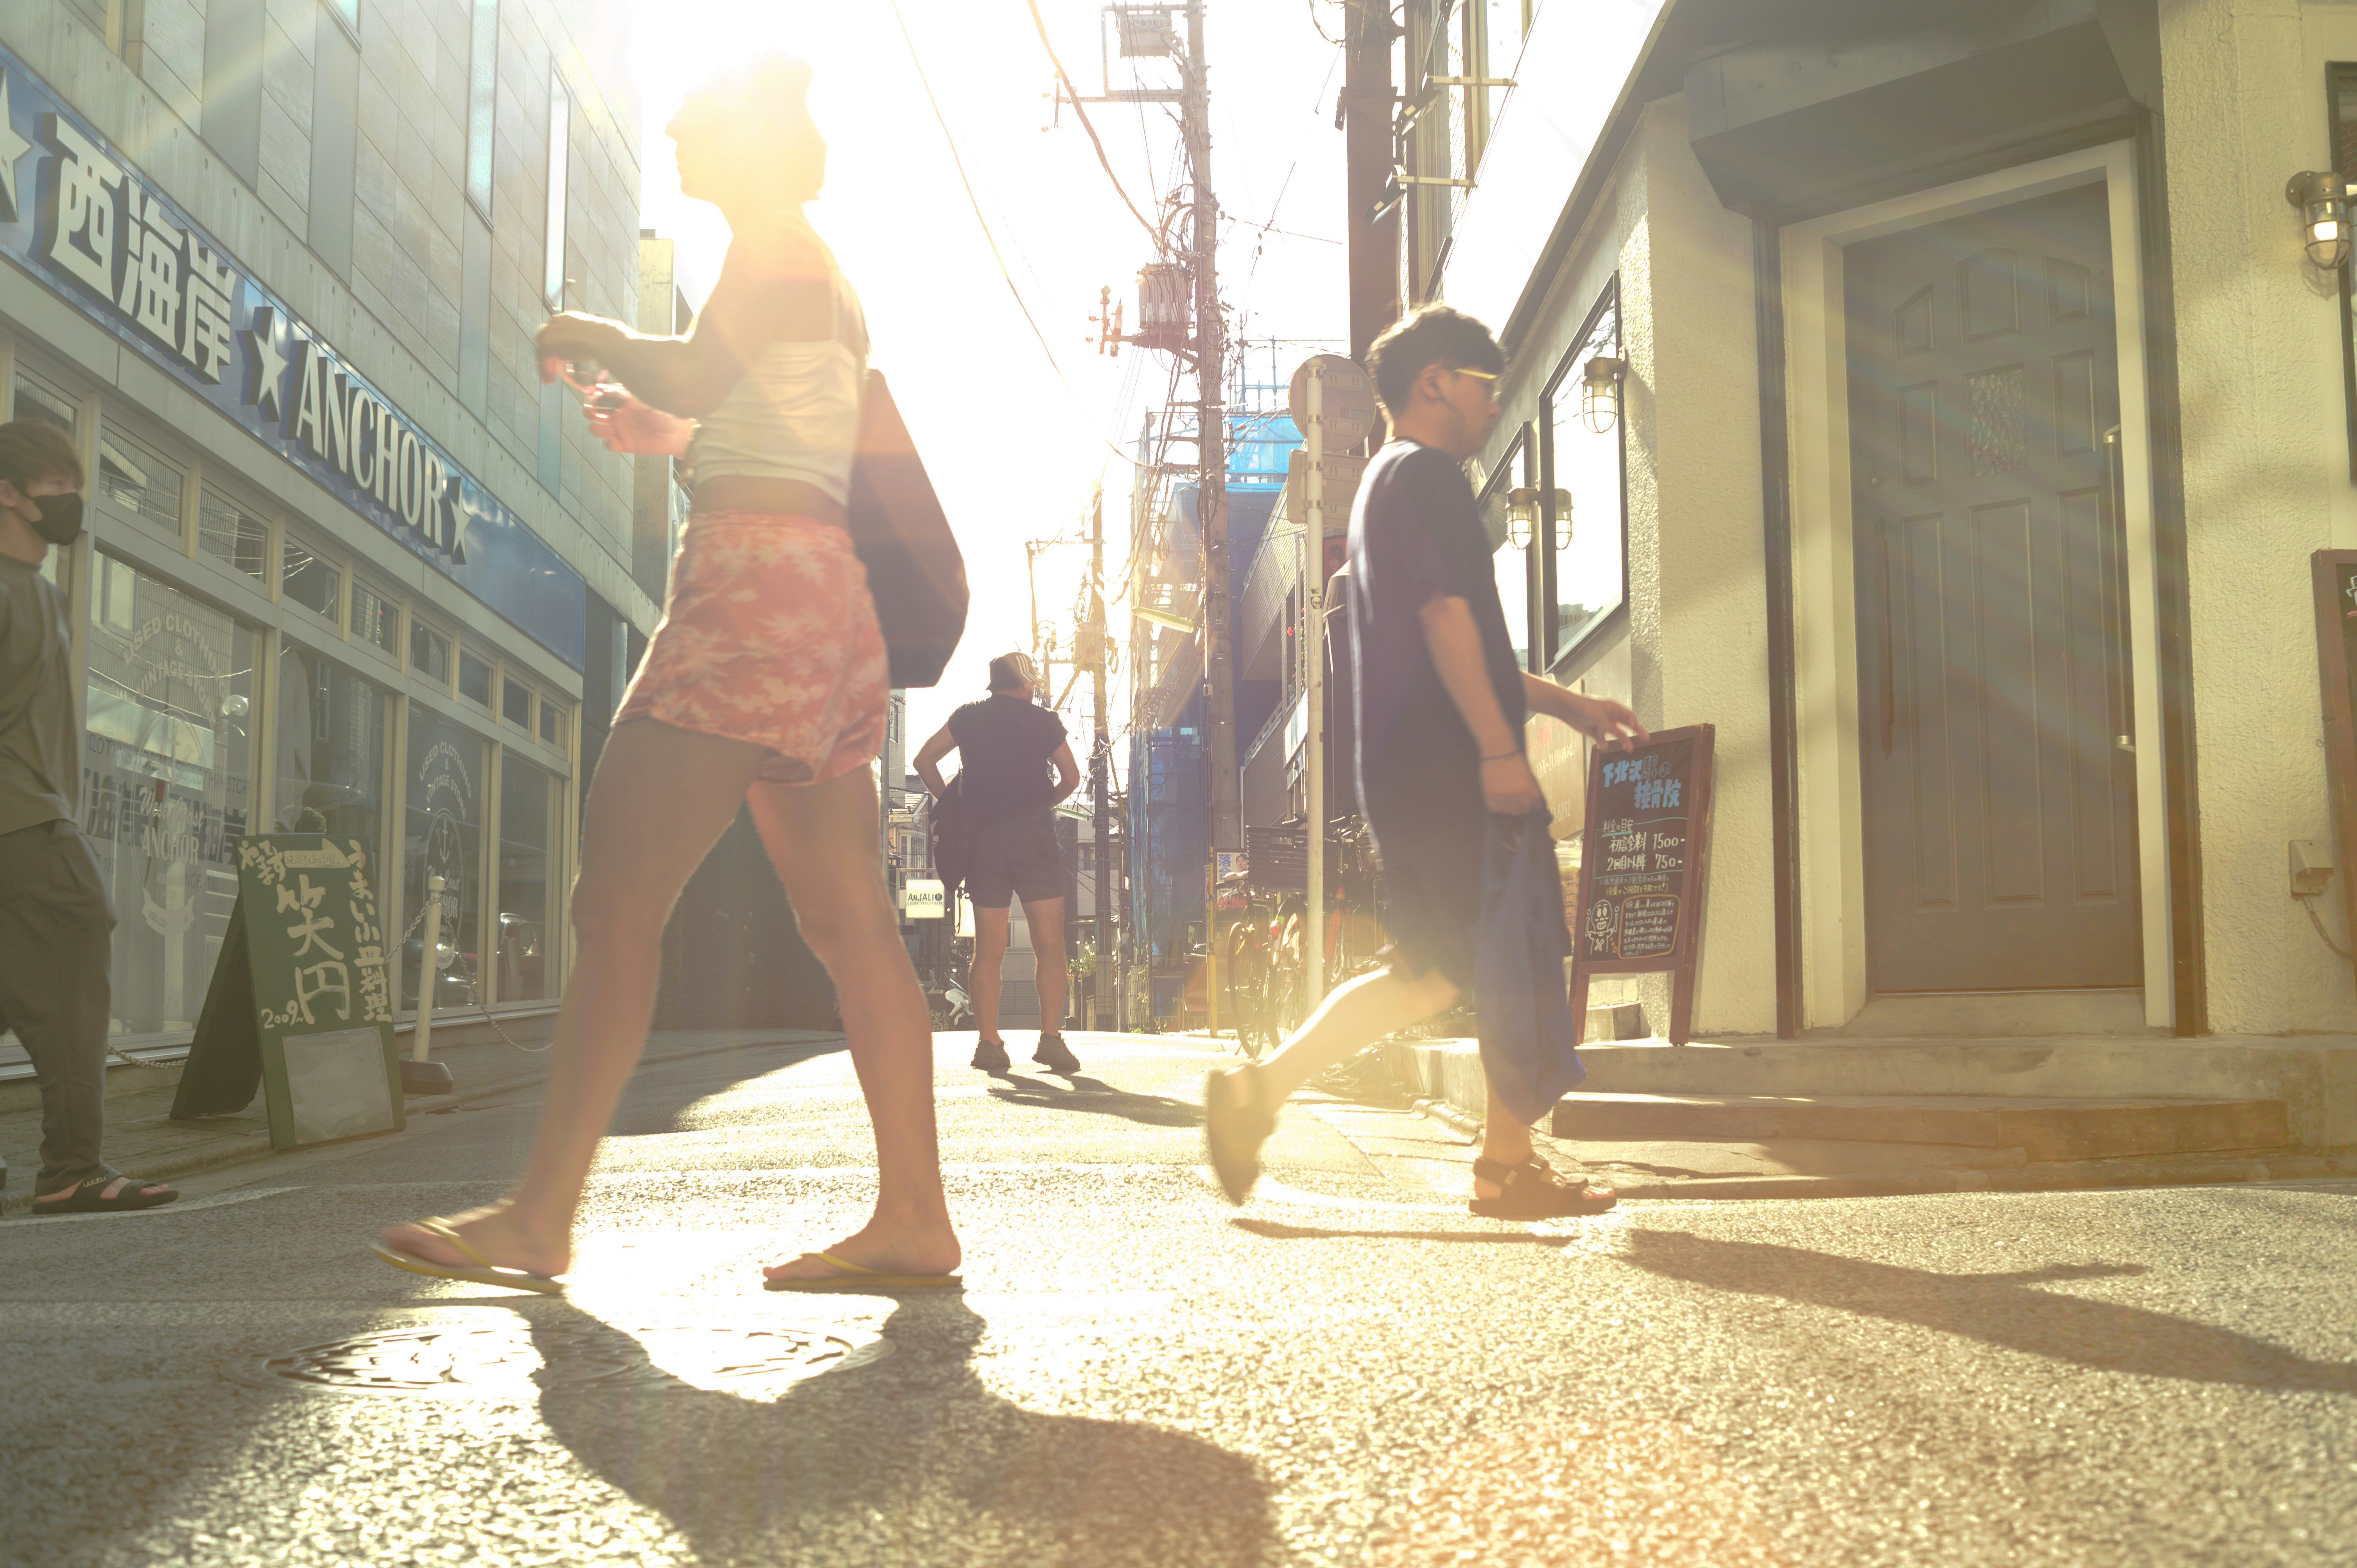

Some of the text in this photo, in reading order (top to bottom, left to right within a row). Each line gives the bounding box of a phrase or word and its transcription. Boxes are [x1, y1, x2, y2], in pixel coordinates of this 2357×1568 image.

[50, 113, 237, 385] 西海岸
[295, 340, 444, 548] ANCHOR
[123, 614, 229, 701] USED CLOTHING
[175, 639, 184, 657] &
[136, 660, 216, 730] VINTAGE STORE
[419, 742, 472, 799] USED CLOTHING
[444, 758, 449, 770] &
[1603, 755, 1671, 788] 下北沢駅の
[139, 786, 169, 819] West
[426, 774, 466, 822] VINTAGE STORE
[1634, 779, 1682, 810] 接骨院
[141, 825, 199, 866] ANCHOR
[1606, 853, 1647, 871] 2回目以降
[1609, 832, 1647, 853] 初診料
[276, 874, 350, 1025] 笑円
[347, 839, 392, 1022] うまい小皿料理
